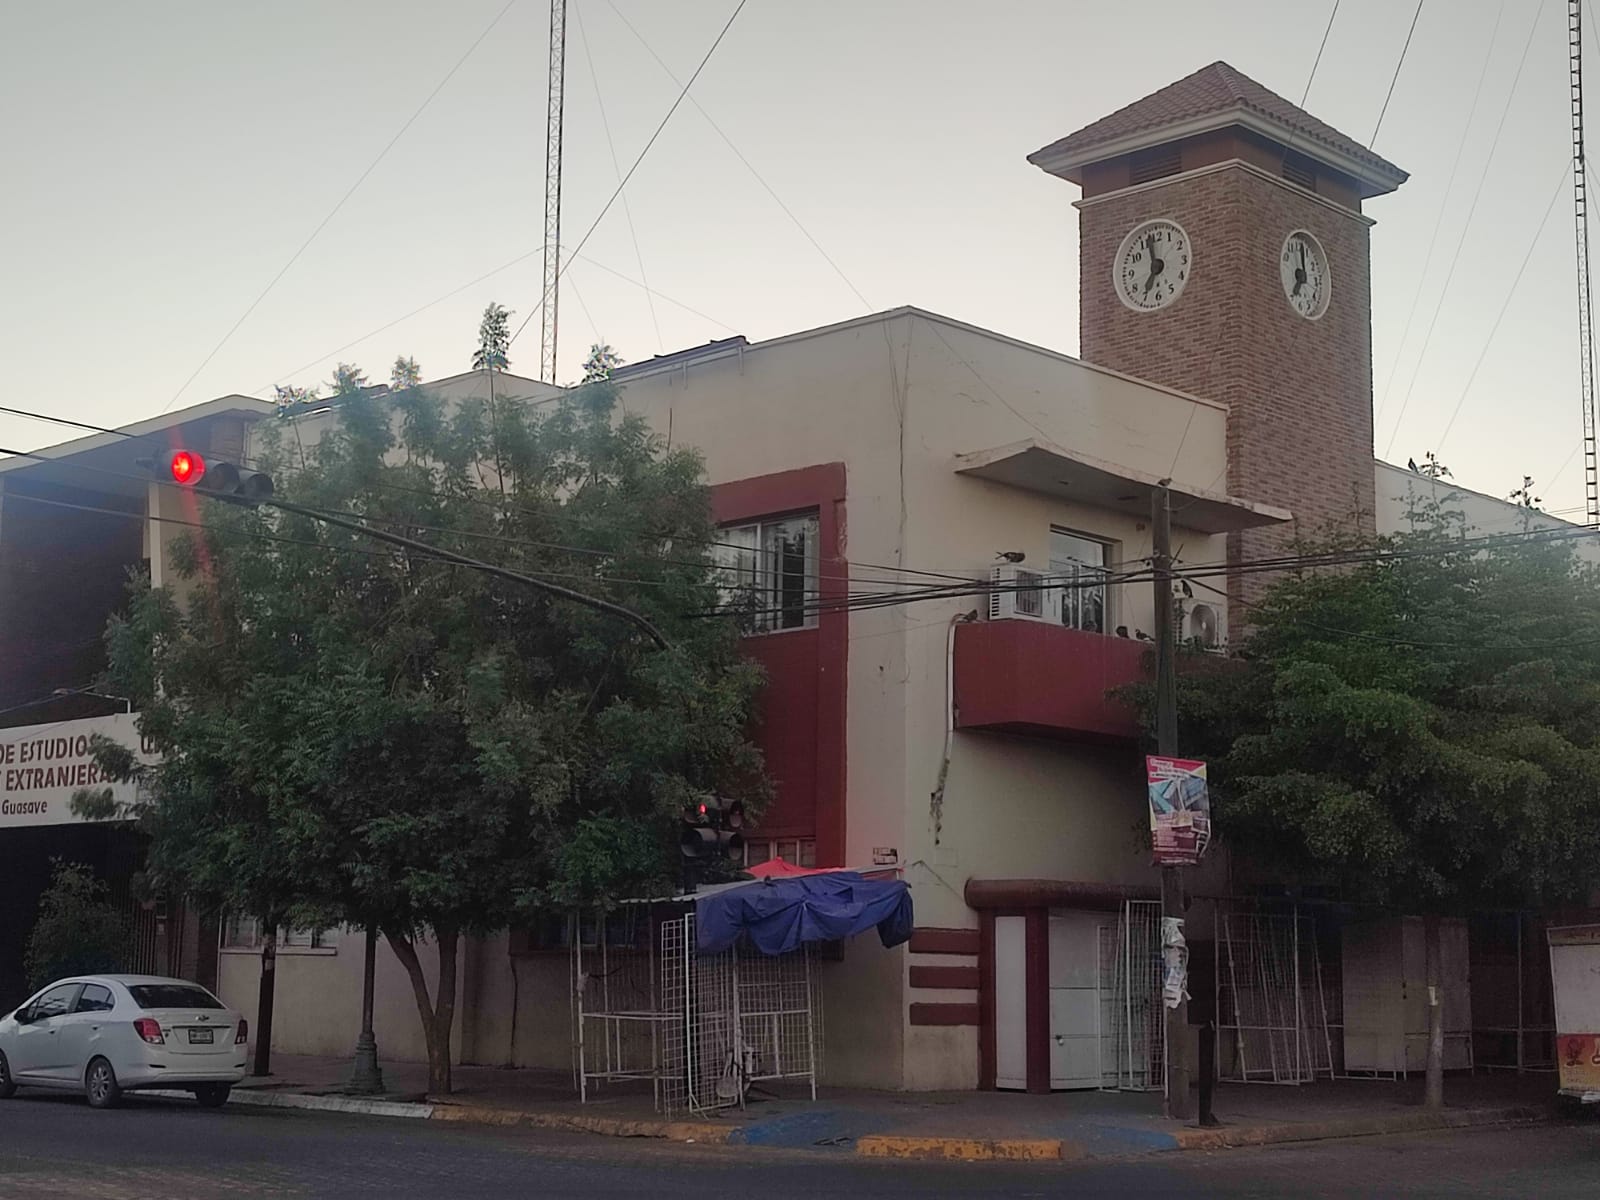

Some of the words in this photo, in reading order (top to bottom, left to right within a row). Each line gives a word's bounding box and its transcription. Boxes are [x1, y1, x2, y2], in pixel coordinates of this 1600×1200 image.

[1152, 231, 1162, 243] 12
[1167, 232, 1172, 242] 1
[1176, 240, 1183, 251] 2
[1131, 252, 1142, 264] 10
[1181, 255, 1187, 265] 3
[1128, 270, 1135, 280] 9
[1168, 283, 1174, 294] 5
[1155, 291, 1162, 301] 6
[6, 763, 113, 791] EXTRANJERA
[2, 799, 47, 815] Guasave
